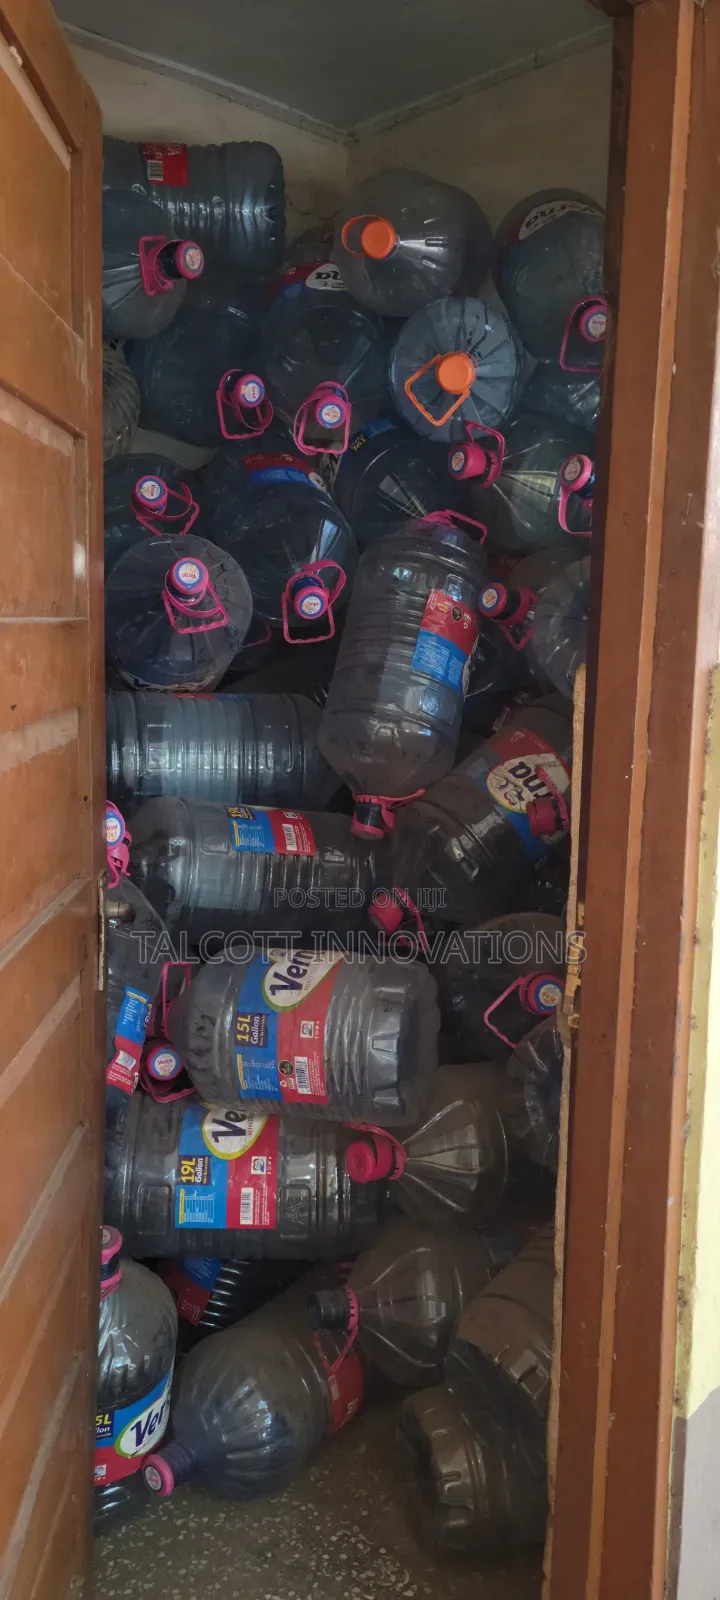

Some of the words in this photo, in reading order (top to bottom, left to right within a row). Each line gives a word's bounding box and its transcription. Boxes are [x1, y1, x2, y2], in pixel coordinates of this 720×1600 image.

[236, 1014, 251, 1042] 15L
[250, 1015, 261, 1044] Gallon
[211, 1108, 247, 1144] Ve
[181, 1157, 196, 1183] 19L
[194, 1157, 204, 1183] Gallon
